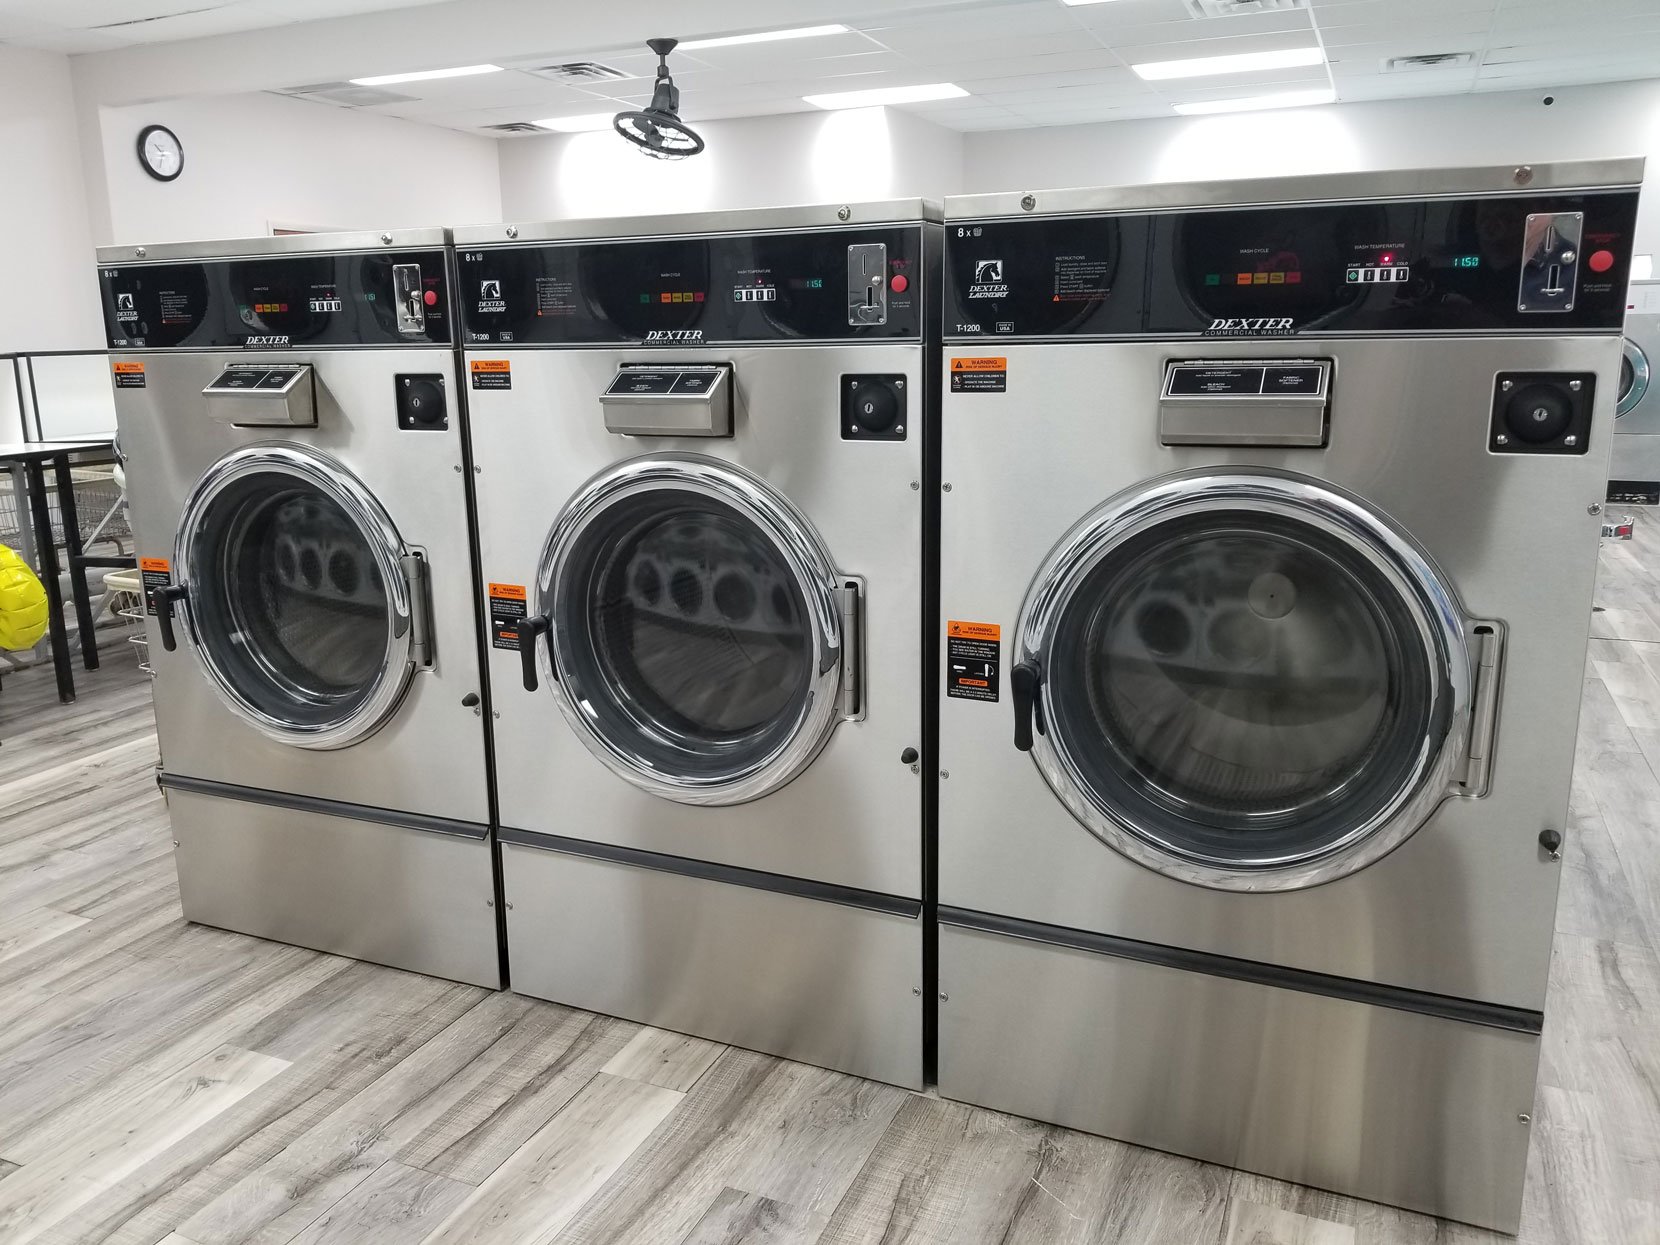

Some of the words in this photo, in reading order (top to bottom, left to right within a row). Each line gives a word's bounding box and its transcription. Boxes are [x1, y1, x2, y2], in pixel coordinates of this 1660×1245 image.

[957, 227, 964, 237] 8
[465, 253, 471, 262] 8
[968, 284, 1009, 292] DEXTER
[968, 291, 1009, 299] LAUNDRY
[956, 324, 981, 332] T-1200
[1207, 317, 1294, 330] DEXTER
[471, 333, 490, 341] T-1200
[646, 330, 703, 340] DEXTER
[246, 335, 289, 345] DEXTER
